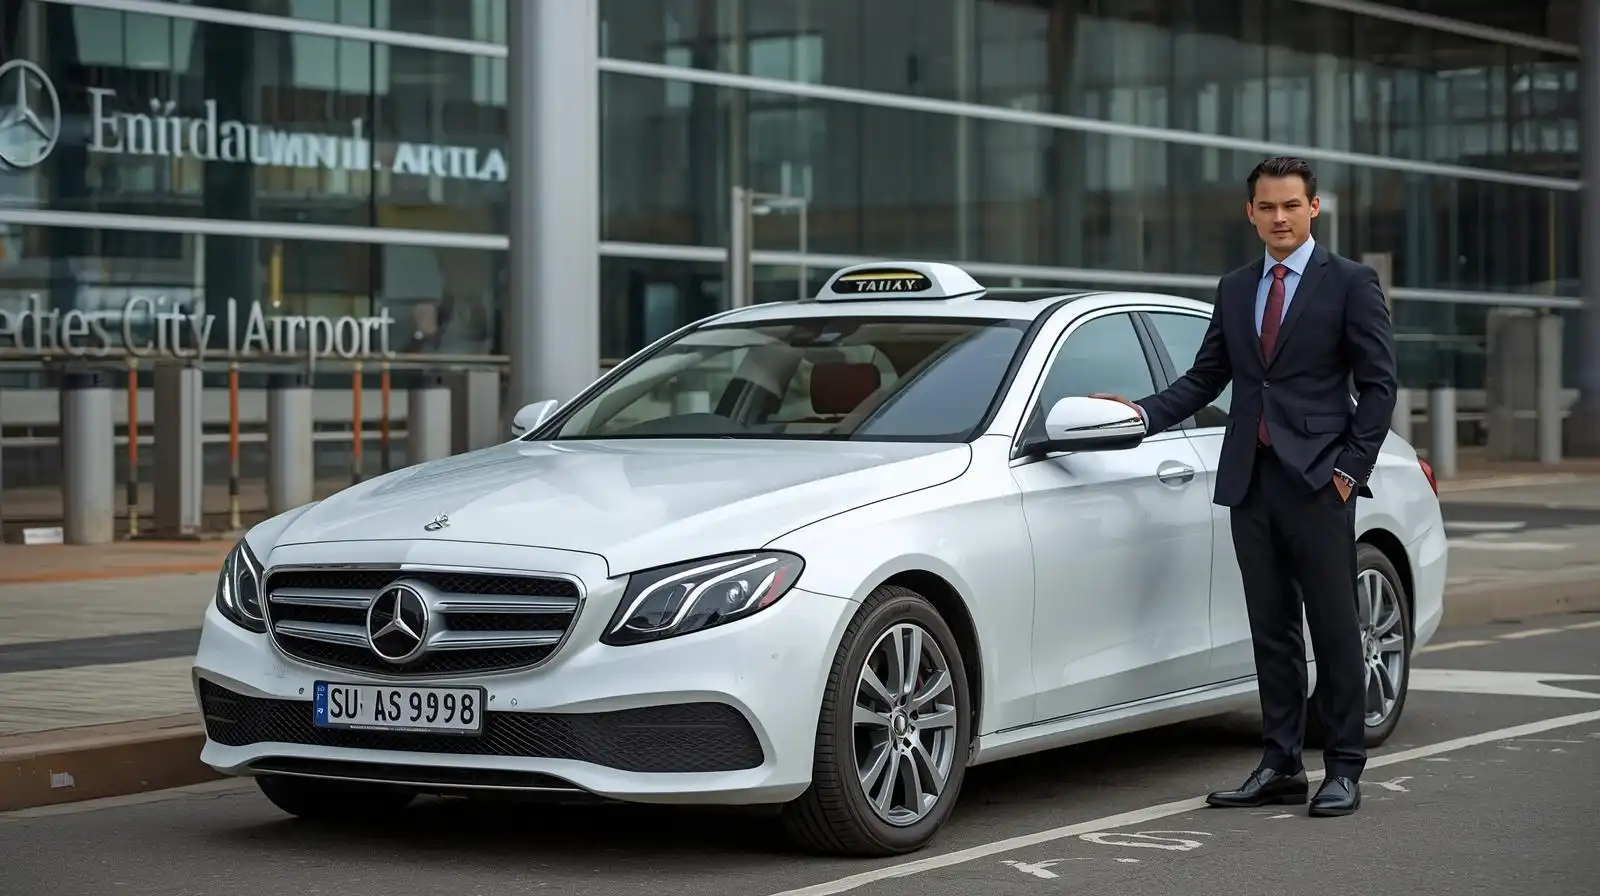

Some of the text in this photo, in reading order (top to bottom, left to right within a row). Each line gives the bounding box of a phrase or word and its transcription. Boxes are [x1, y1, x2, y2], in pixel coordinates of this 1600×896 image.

[123, 295, 216, 365] City
[330, 687, 358, 719] SU
[374, 690, 402, 722] AS
[409, 692, 475, 725] 9998
